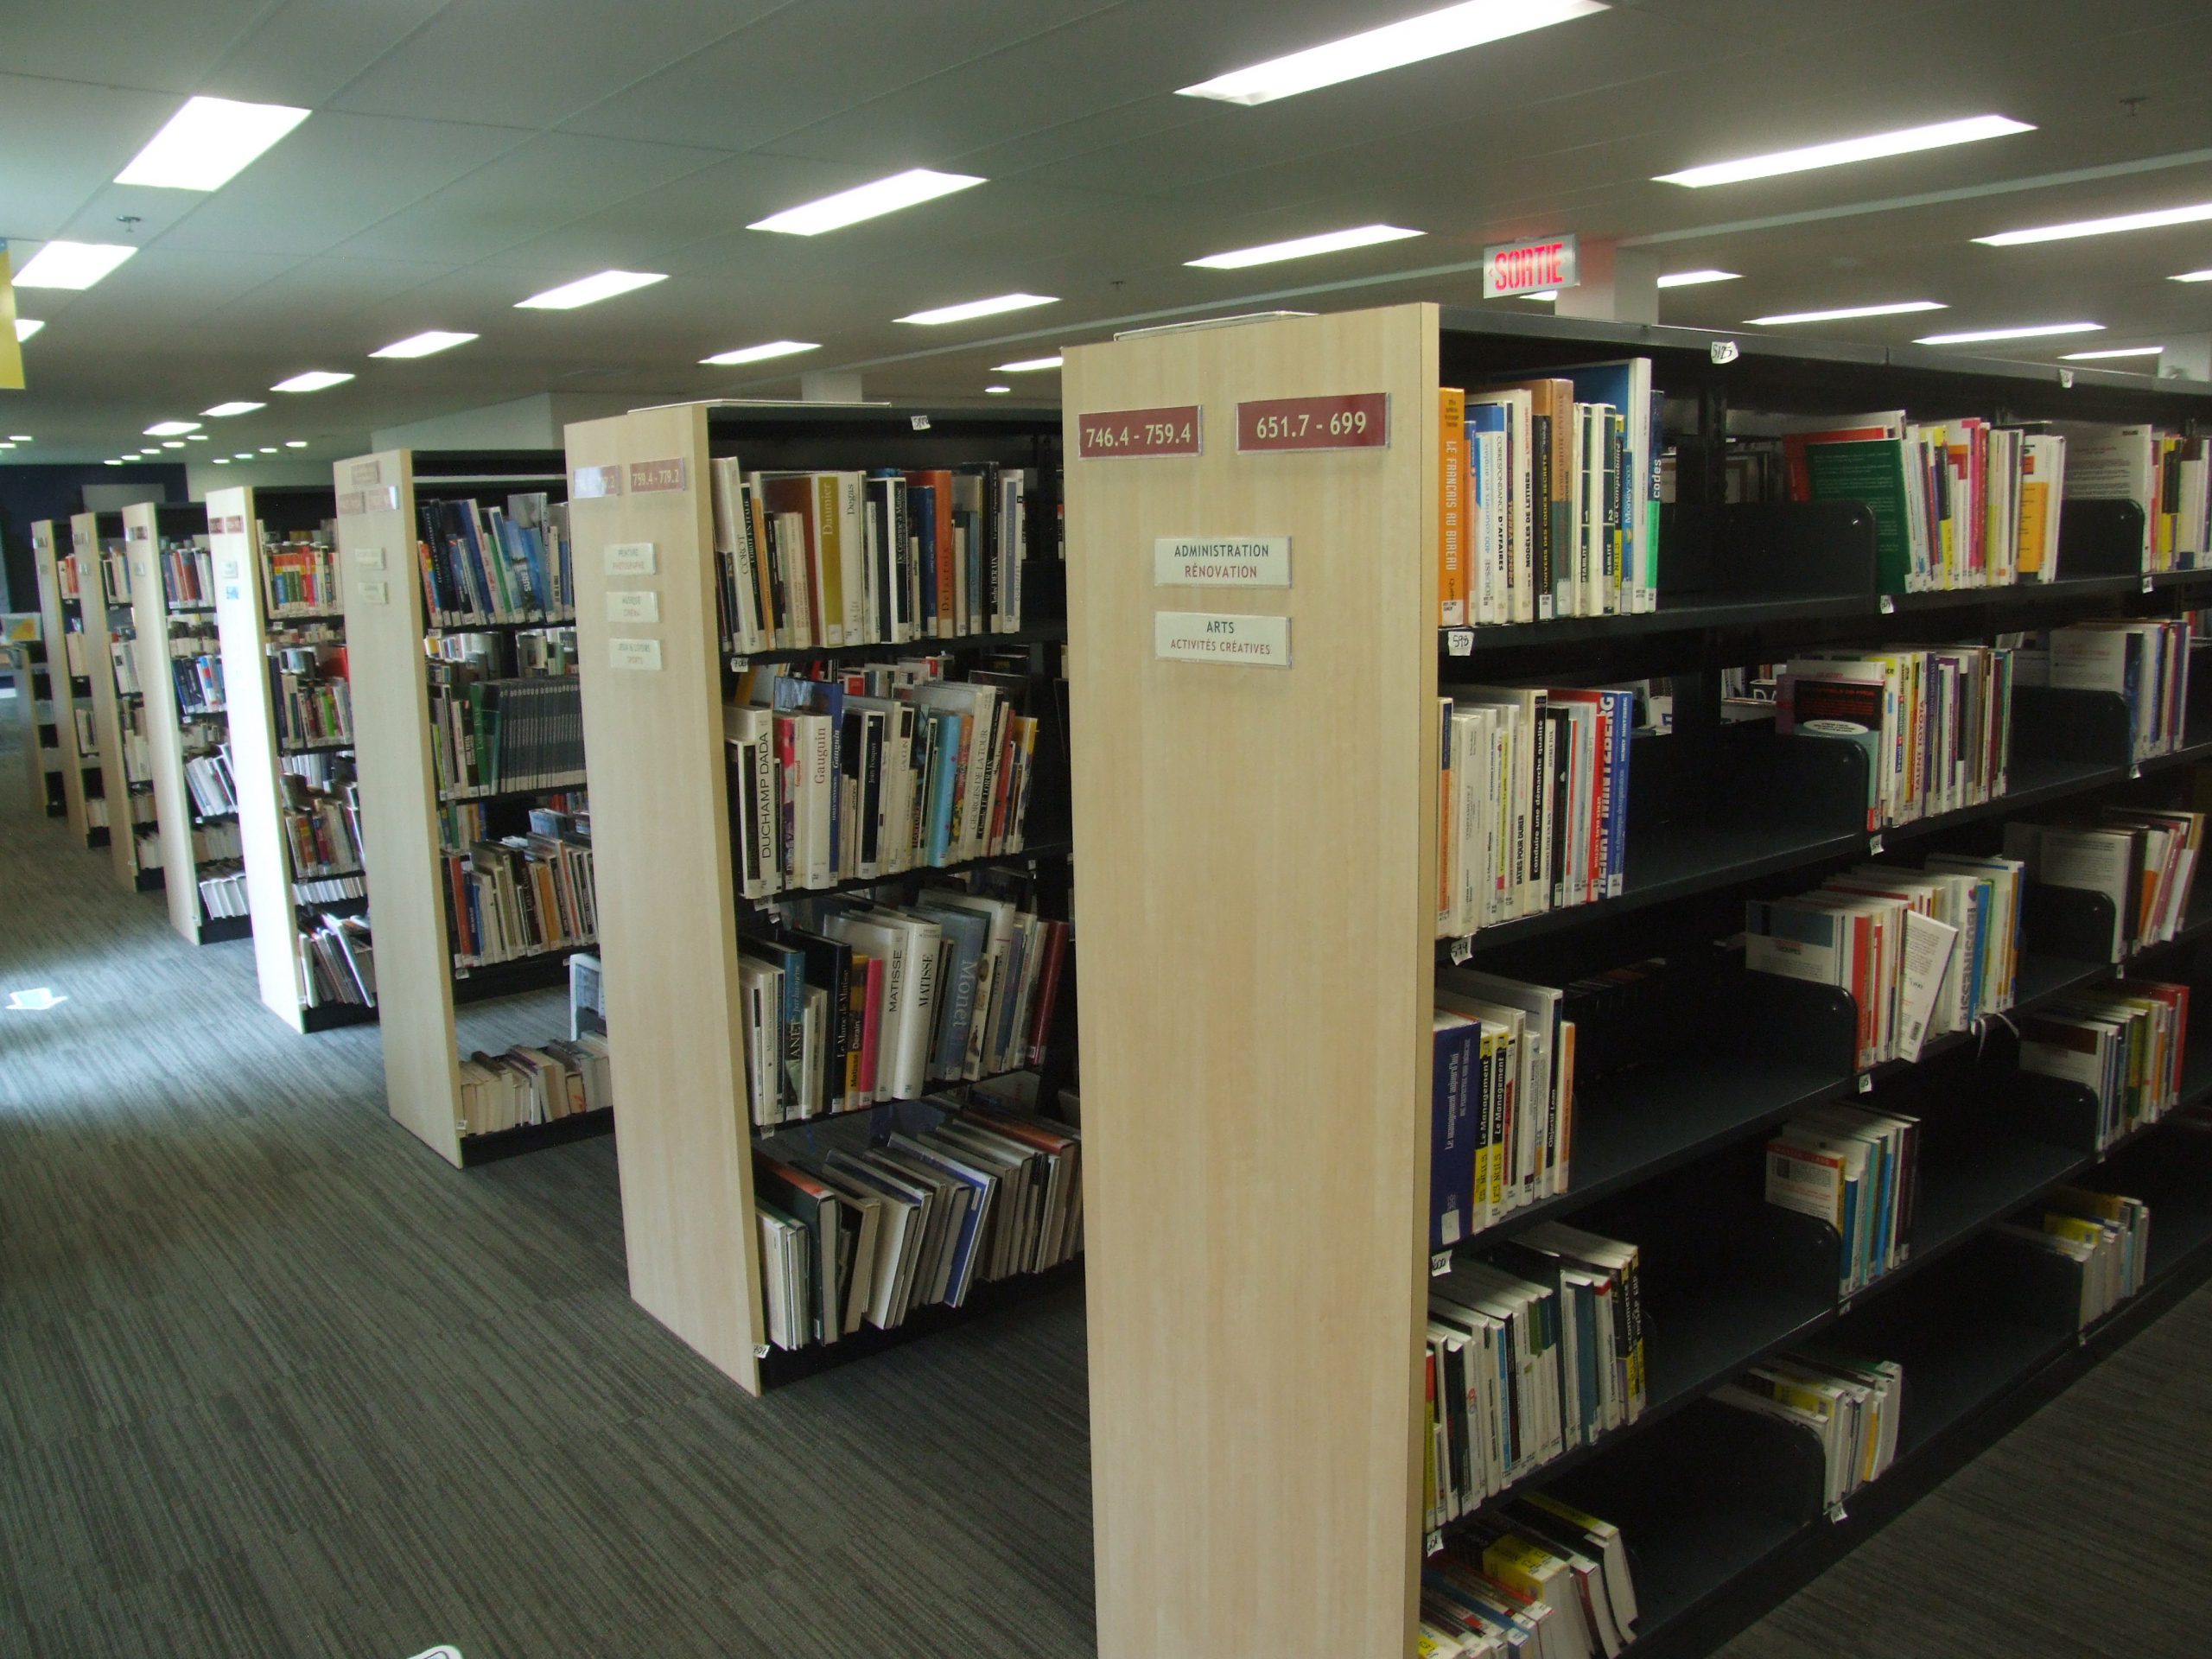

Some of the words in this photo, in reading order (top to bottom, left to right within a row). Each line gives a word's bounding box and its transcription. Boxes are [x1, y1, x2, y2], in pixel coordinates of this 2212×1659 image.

[1495, 243, 1562, 290] SORTIE
[1086, 426, 1128, 448] 746.4
[1145, 423, 1191, 446] 759.4
[1256, 415, 1309, 439] 651.7
[1330, 411, 1366, 435] 699
[1446, 441, 1457, 454] LE
[1651, 459, 1662, 499] codes
[822, 483, 834, 535] Daumier
[846, 484, 856, 514] Degas
[1446, 512, 1457, 527] AU
[737, 535, 749, 574] COROT
[1174, 543, 1269, 557] ADMINISTRATION
[1446, 532, 1457, 570] BUREAU
[1185, 563, 1257, 578] RÉNOVATION
[1206, 621, 1235, 633] ARTS
[1452, 634, 1469, 648] 598
[1170, 639, 1216, 652] ACTIVITÉS
[1220, 639, 1270, 655] CRÉATIVES
[1535, 720, 1545, 755] qualité
[1916, 700, 1924, 747] TOYOTA
[759, 732, 769, 774] DADA
[814, 728, 828, 785] Gauguin
[832, 729, 842, 769] Gauguin
[1533, 759, 1542, 806] démarche
[760, 779, 772, 858] DUCHAMP
[1532, 830, 1541, 874] conduire
[888, 950, 902, 1013] MATISSE
[918, 954, 934, 1007] MATISSE
[952, 959, 977, 1027] Monet
[852, 1020, 861, 1050] Derain
[850, 1053, 860, 1088] Matisse
[1495, 1057, 1505, 1121] Management
[1479, 1060, 1490, 1131] Management
[1479, 1133, 1488, 1146] Le
[1494, 1122, 1502, 1135] Le
